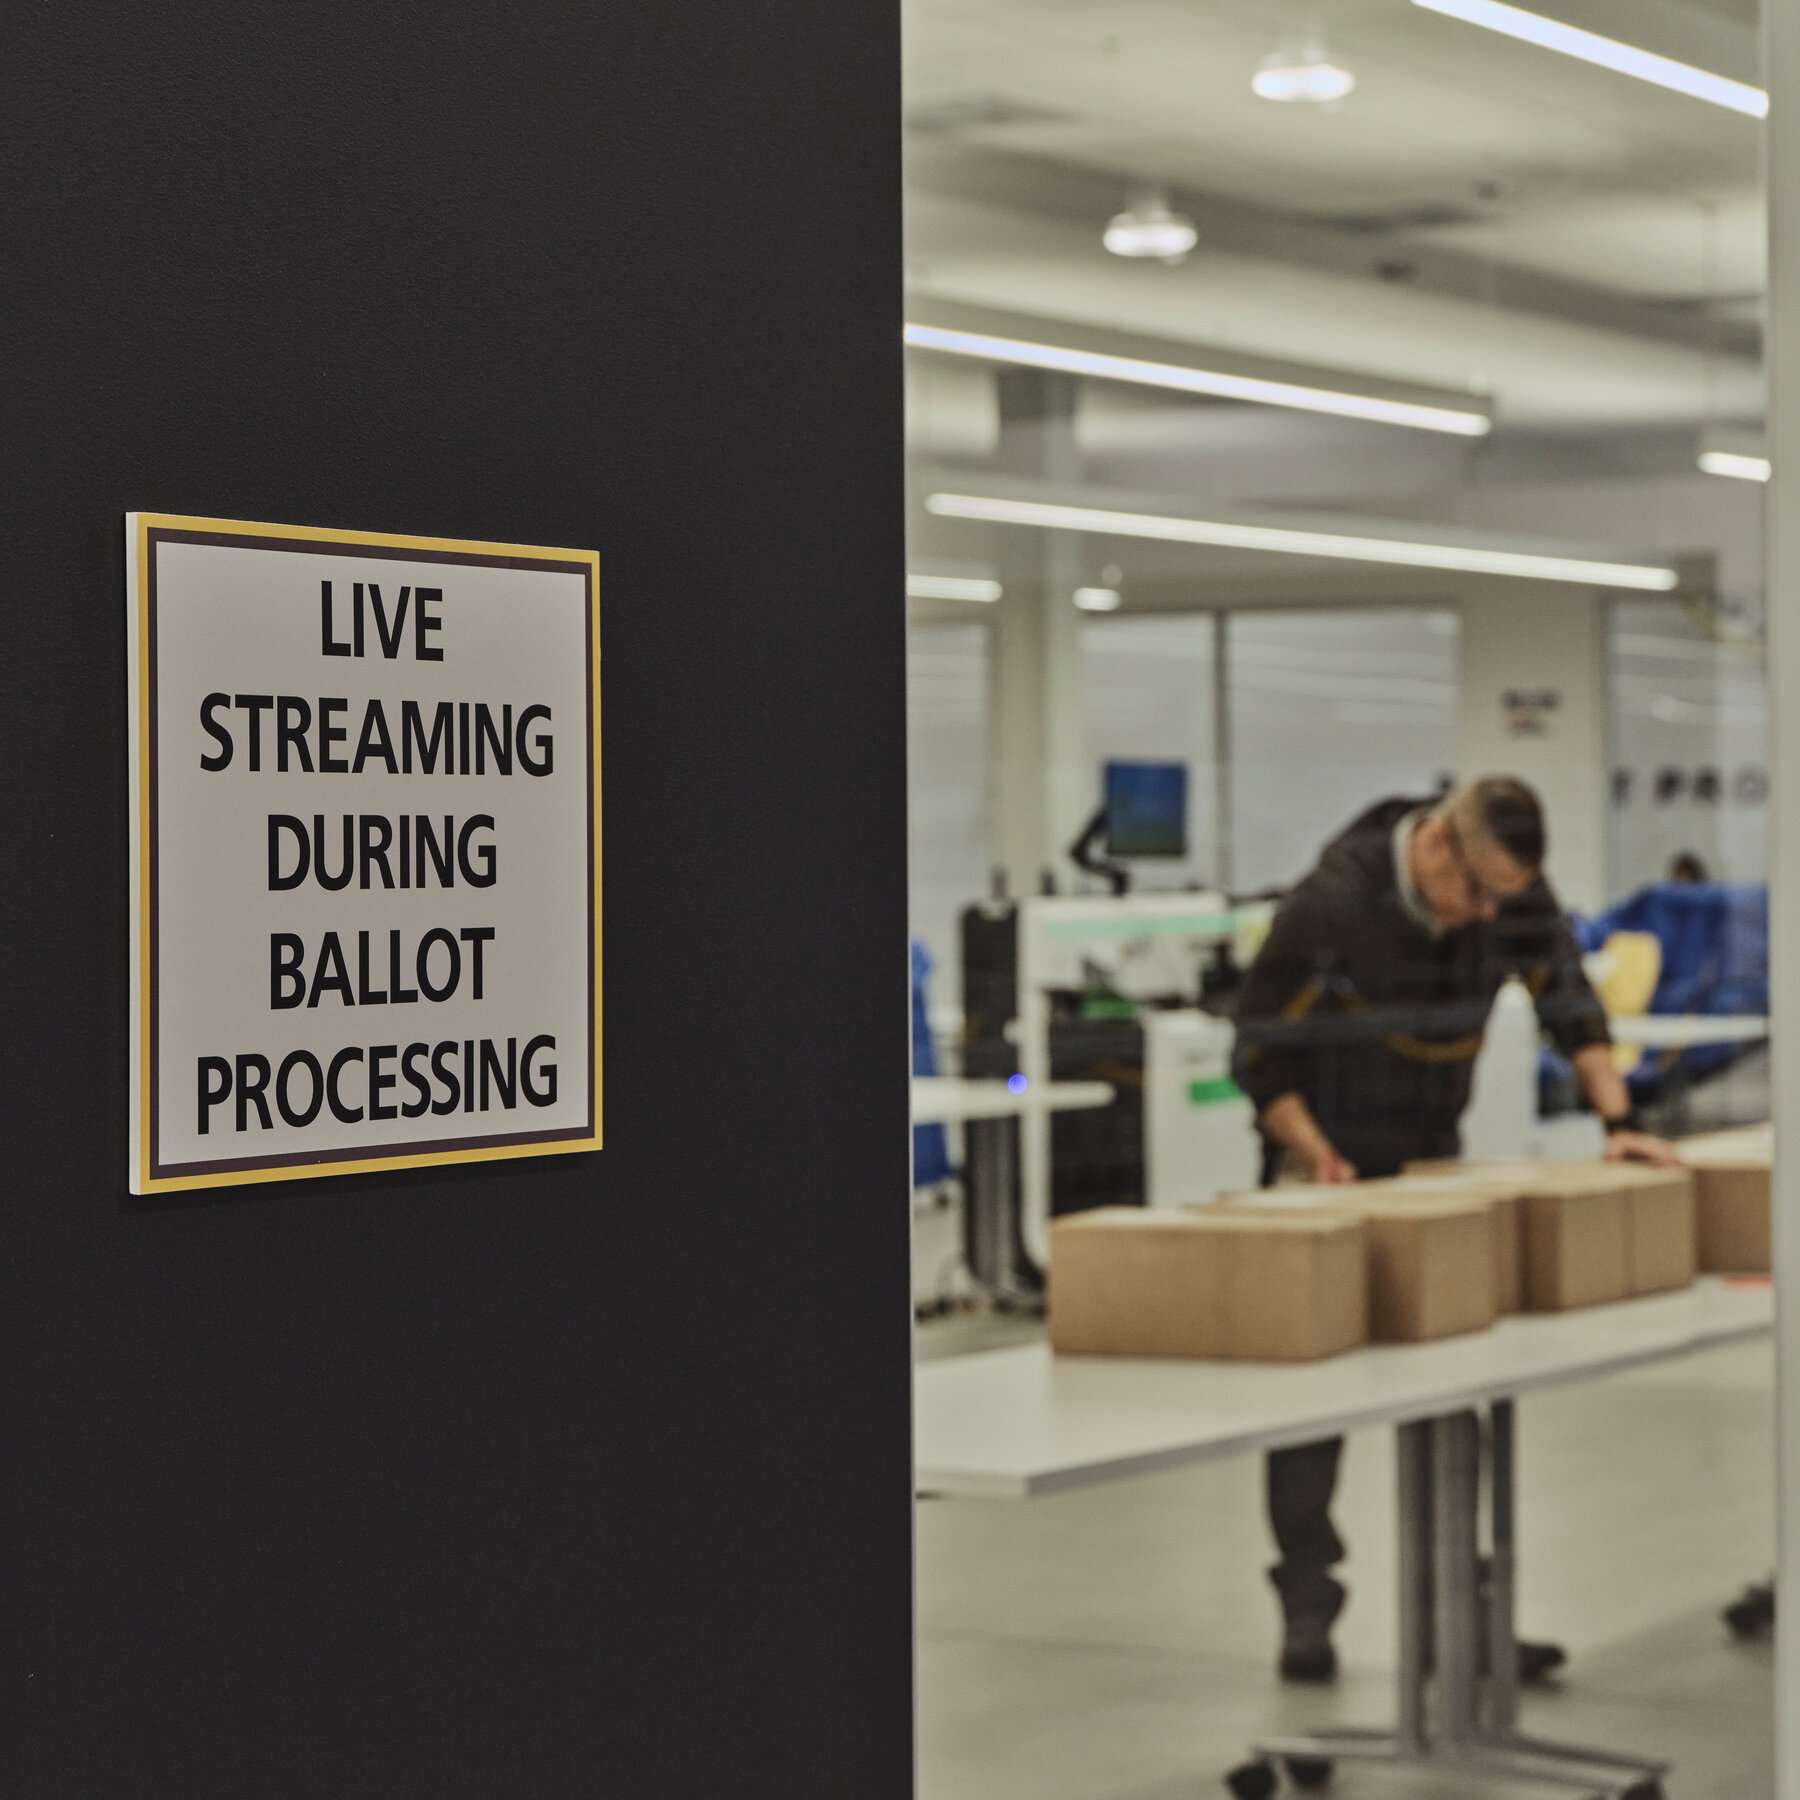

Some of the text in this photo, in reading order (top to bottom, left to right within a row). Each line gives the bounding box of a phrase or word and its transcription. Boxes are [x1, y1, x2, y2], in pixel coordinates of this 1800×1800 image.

[321, 580, 444, 662] LIVE
[199, 692, 554, 778] STREAMING
[267, 813, 497, 892] DURING
[270, 926, 496, 1011] BALLOT
[197, 1034, 558, 1136] PROCESSING
